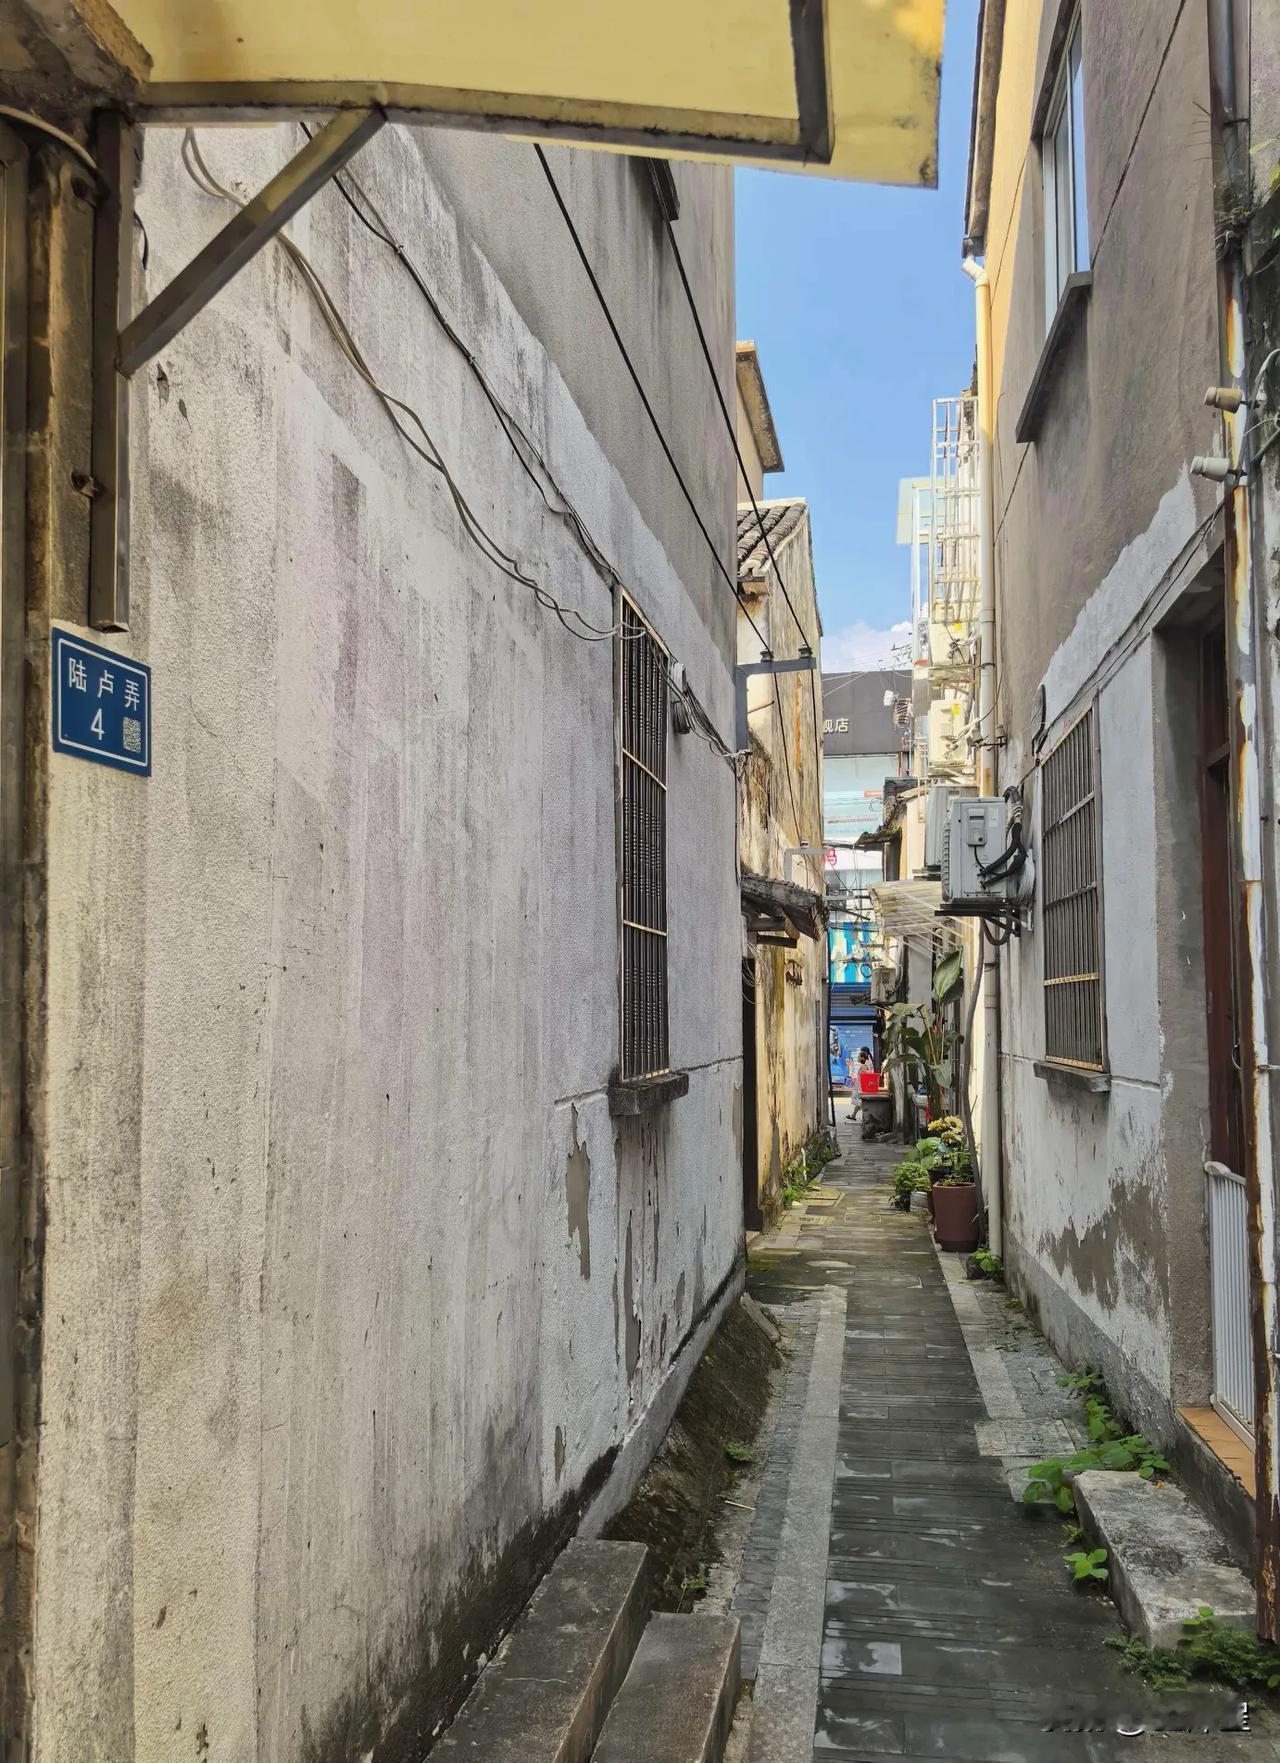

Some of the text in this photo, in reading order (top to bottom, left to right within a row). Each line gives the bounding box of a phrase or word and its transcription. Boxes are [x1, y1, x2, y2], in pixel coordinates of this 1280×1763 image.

[68, 657, 140, 712] 陆卢弄
[90, 708, 105, 741] 4
